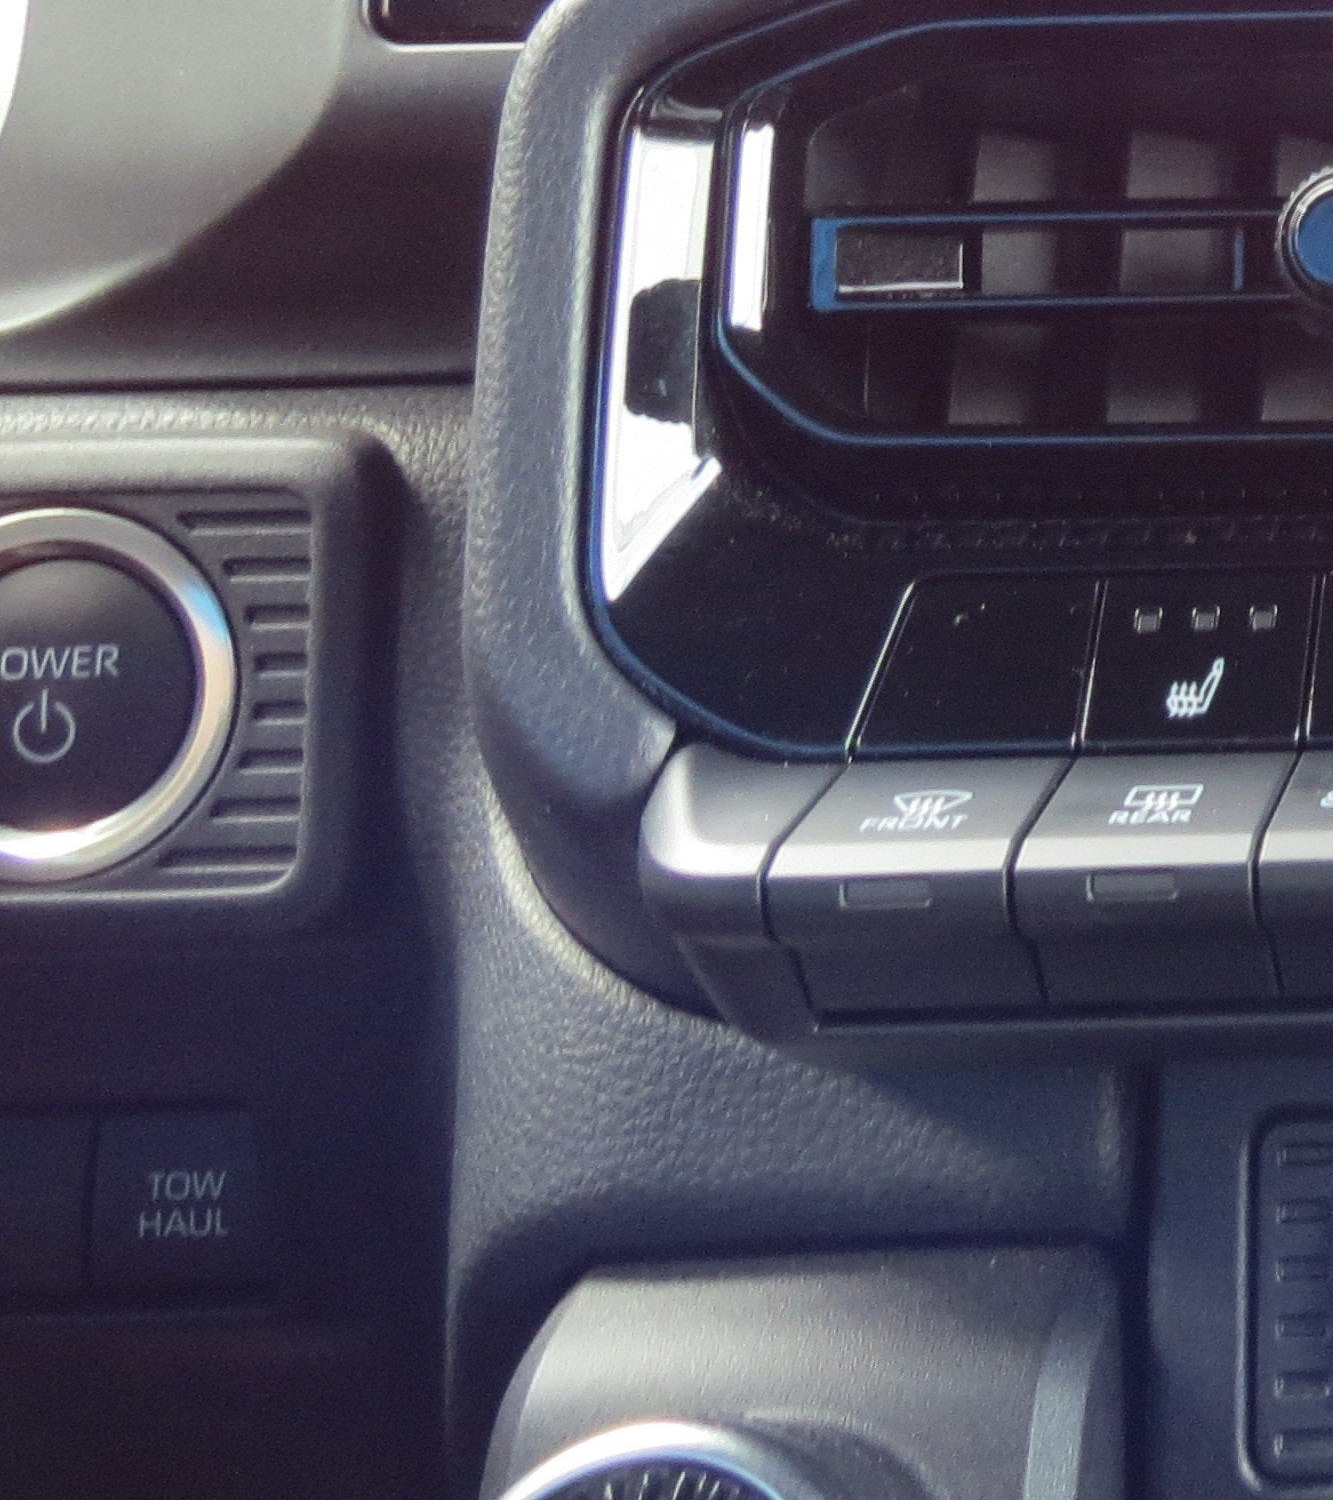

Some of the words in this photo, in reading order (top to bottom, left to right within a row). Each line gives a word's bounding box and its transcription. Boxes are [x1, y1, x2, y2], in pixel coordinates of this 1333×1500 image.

[0, 643, 119, 681] OWER
[859, 812, 969, 833] FRONT
[1108, 807, 1193, 826] REAR
[149, 1169, 228, 1203] TOW
[138, 1208, 229, 1240] HAUL
